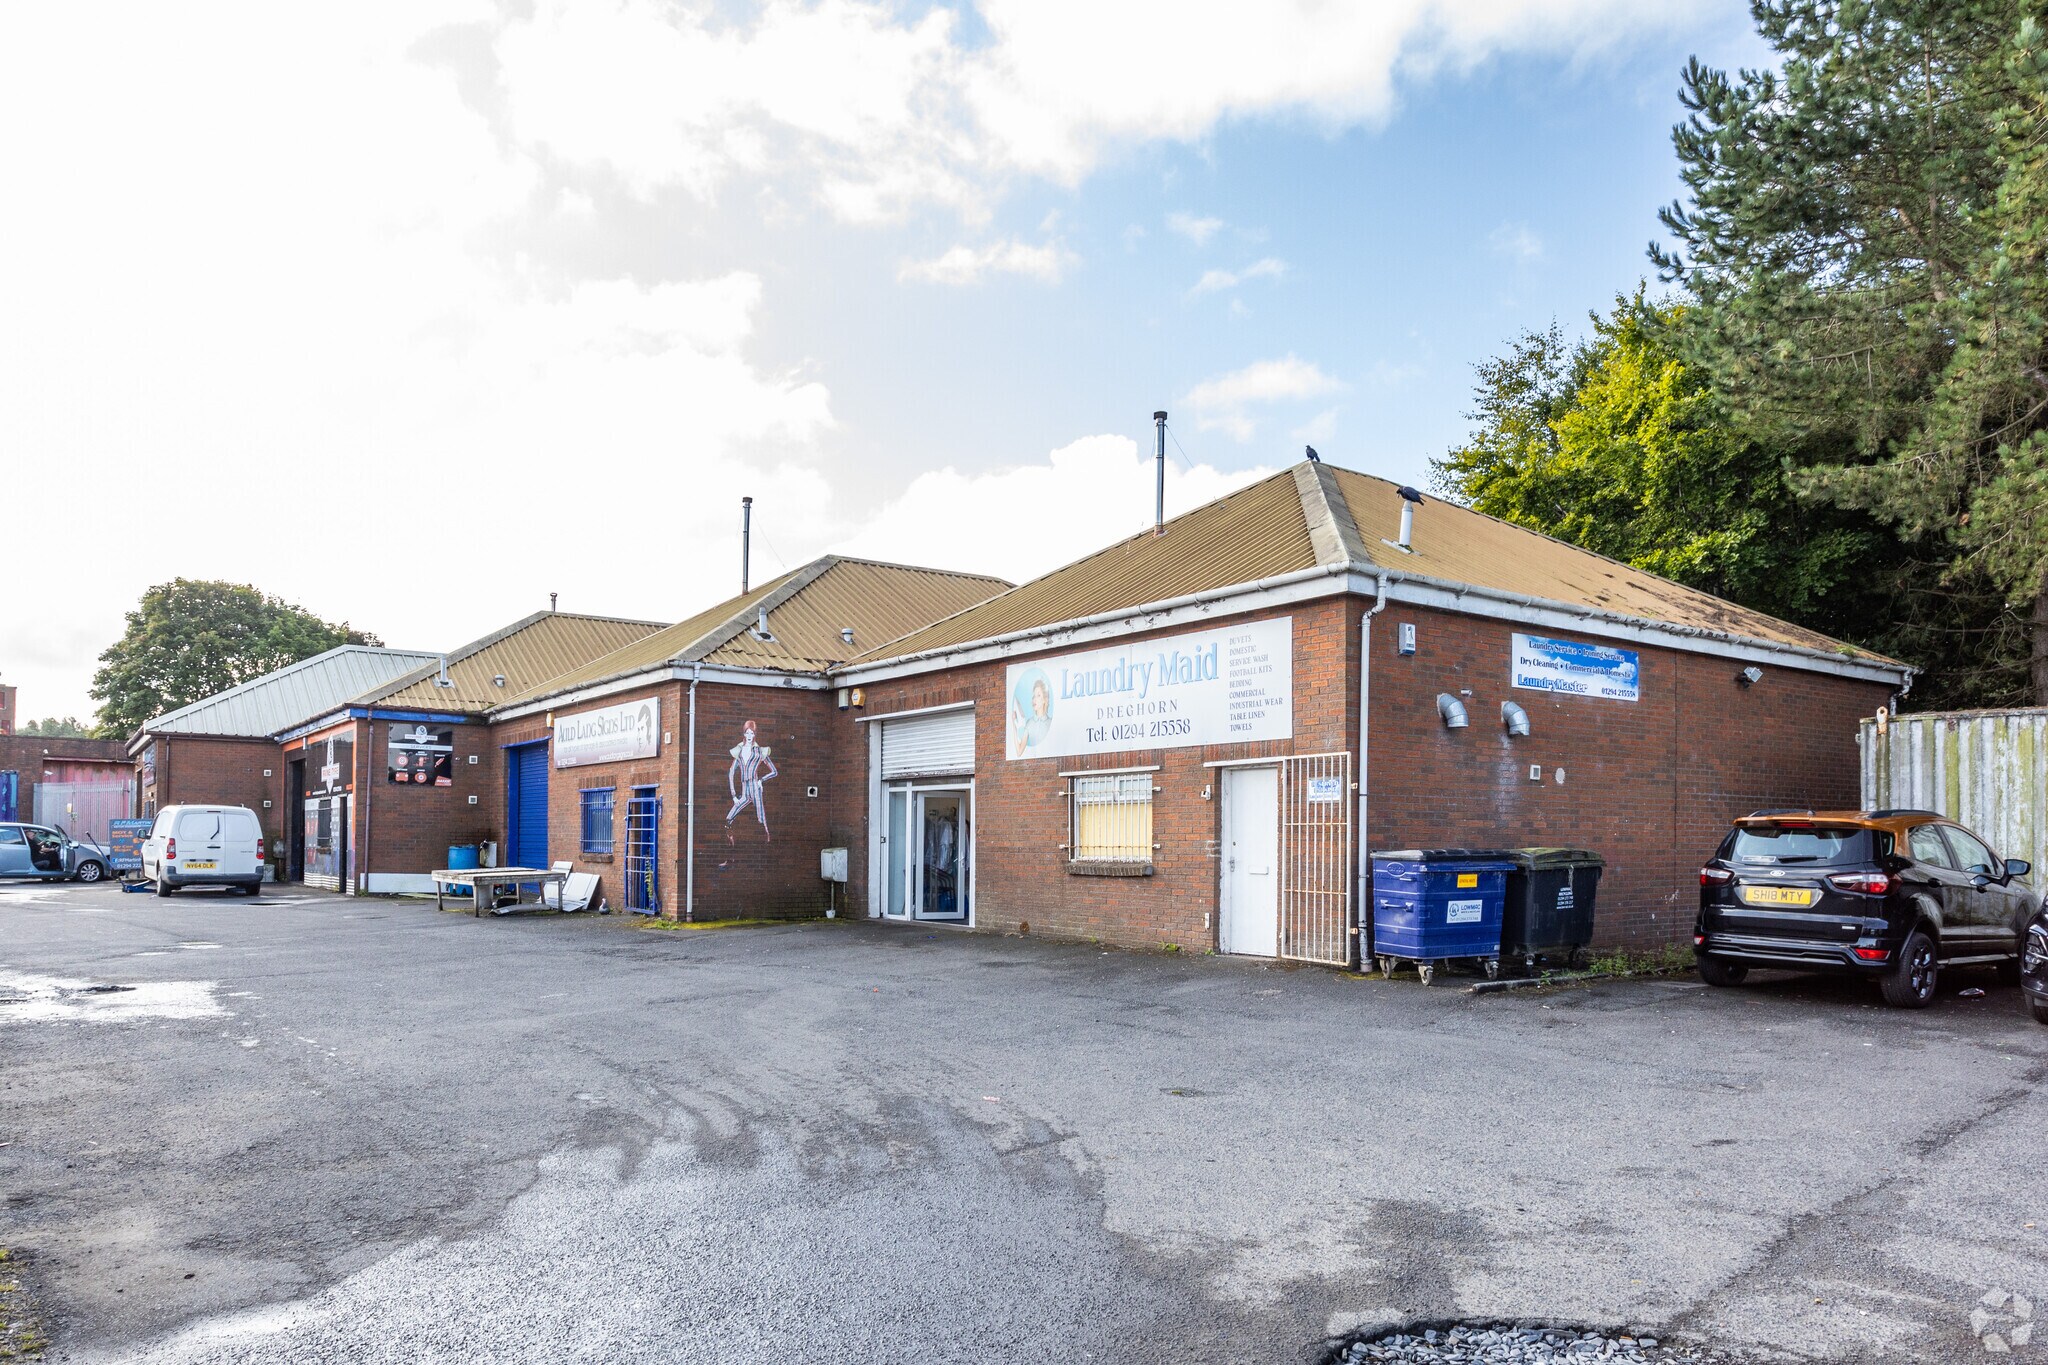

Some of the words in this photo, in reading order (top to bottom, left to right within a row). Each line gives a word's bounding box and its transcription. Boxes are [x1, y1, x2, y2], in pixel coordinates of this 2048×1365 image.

[1230, 635, 1252, 645] DUVETS
[1230, 646, 1256, 656] DOMESTIC
[1528, 641, 1554, 654] Laundry
[1554, 644, 1577, 655] Service
[1583, 648, 1603, 658] Ironing
[1604, 651, 1625, 662] Service
[1230, 656, 1252, 667] SERVICE
[1253, 654, 1268, 663] WASH
[1520, 656, 1532, 667] Dry
[1532, 658, 1558, 670] Cleaning
[1060, 656, 1154, 699] Laundry
[1157, 642, 1219, 687] Maid
[1230, 668, 1257, 678] FOOTBALL
[1258, 665, 1272, 673] KITS
[1230, 679, 1252, 688] BEDDING
[1229, 688, 1266, 699] COMMERCIAL
[1602, 687, 1616, 695] 01294
[1096, 699, 1179, 720] DREGHORN
[1230, 700, 1263, 710] INDUSTRIAL
[1230, 712, 1247, 721] TABLE
[1248, 710, 1265, 719] LINEN
[1086, 727, 1108, 743] Tel:
[1112, 721, 1145, 741] 01294
[1150, 718, 1191, 738] 215558
[1230, 723, 1252, 732] TOWELS
[1754, 890, 1777, 900] SH18
[1781, 891, 1803, 902] MTY
